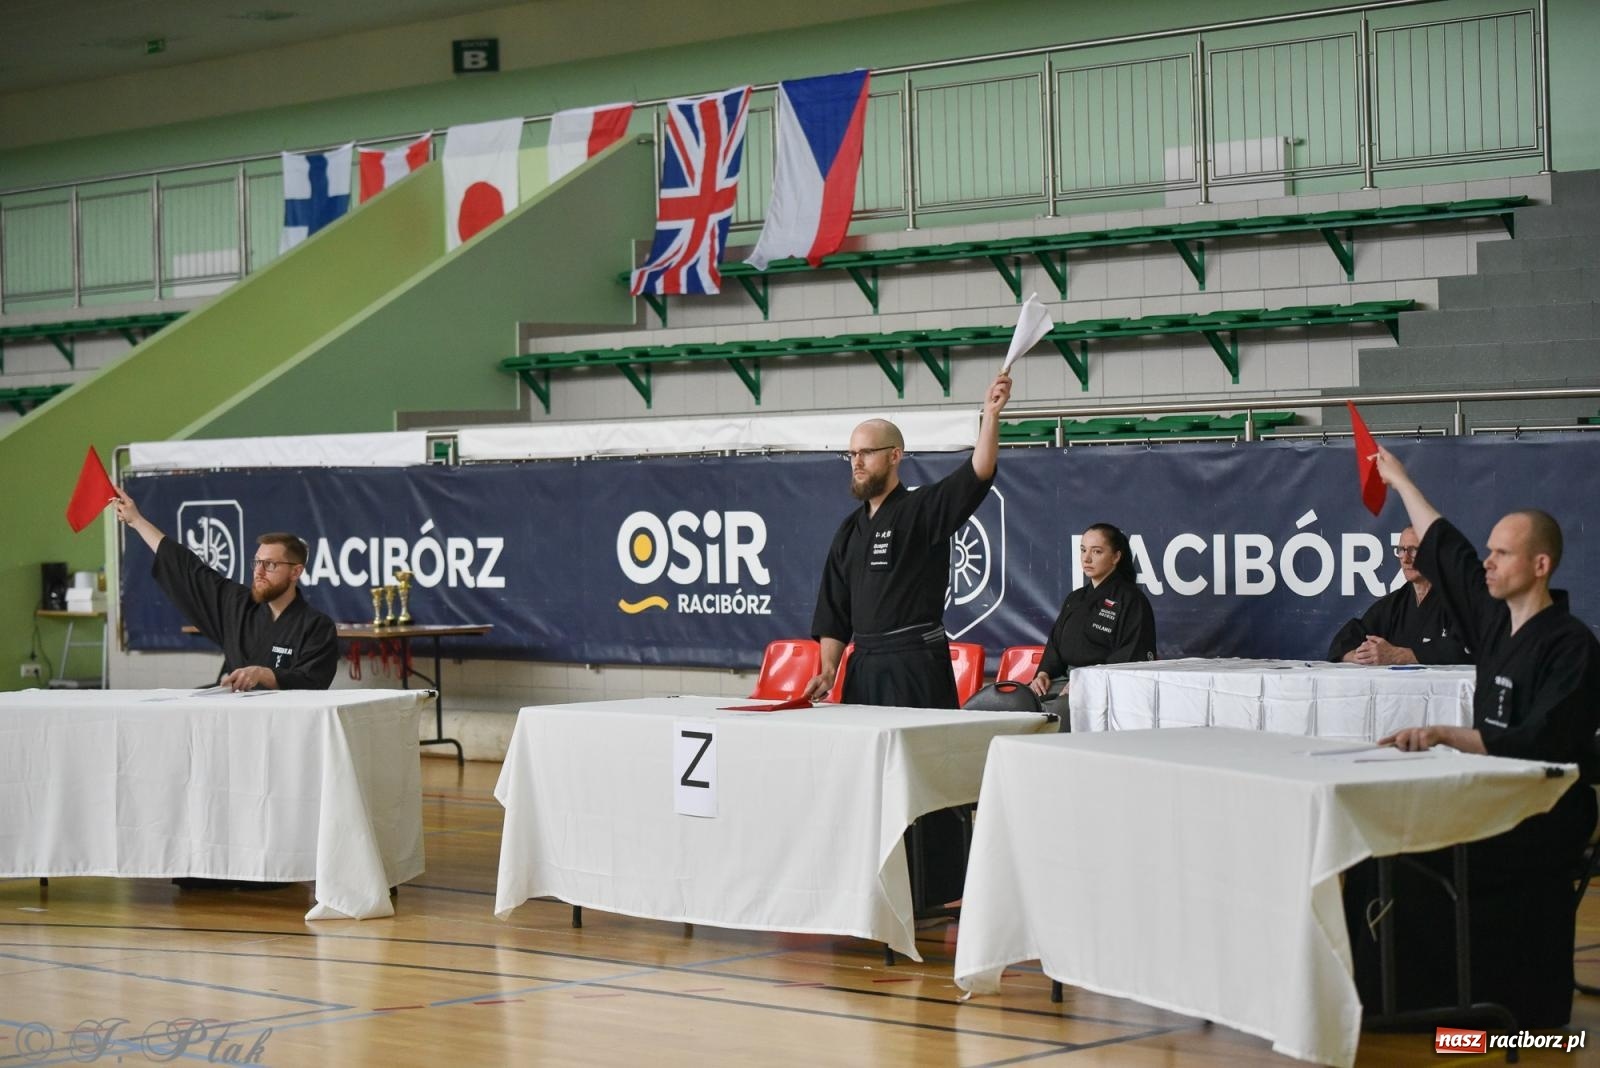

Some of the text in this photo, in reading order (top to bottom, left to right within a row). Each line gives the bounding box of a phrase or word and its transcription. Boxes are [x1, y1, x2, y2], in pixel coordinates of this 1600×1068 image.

[463, 50, 488, 69] B
[677, 588, 772, 615] RACIBÓRZ
[1092, 622, 1112, 633] POLAND
[680, 730, 713, 789] Z
